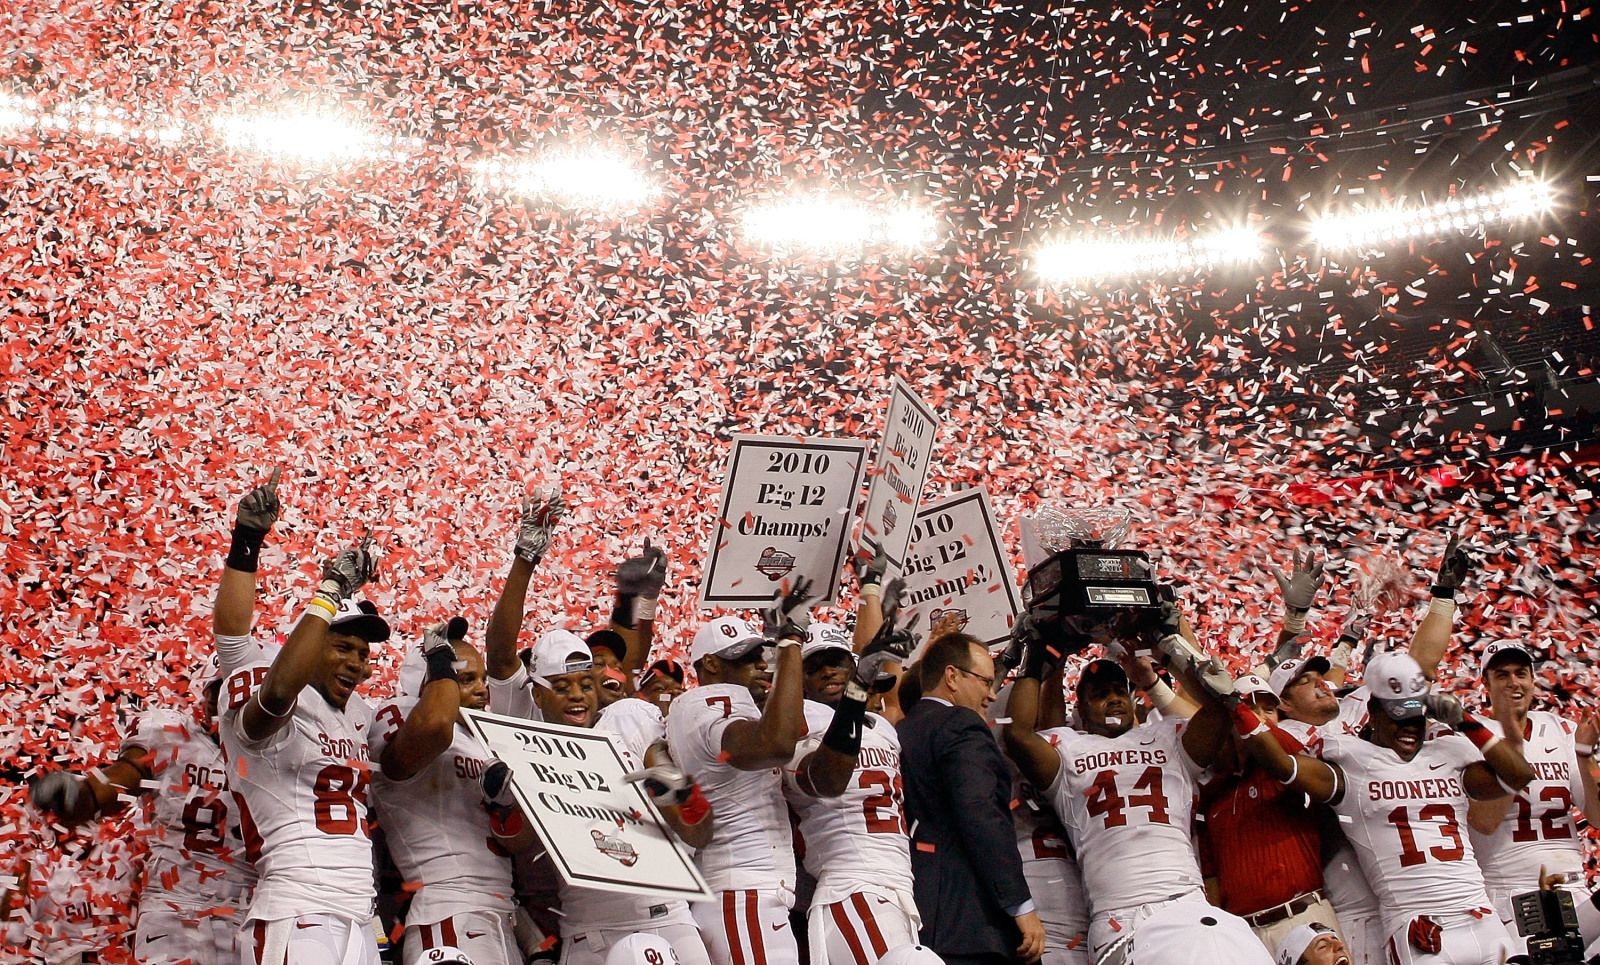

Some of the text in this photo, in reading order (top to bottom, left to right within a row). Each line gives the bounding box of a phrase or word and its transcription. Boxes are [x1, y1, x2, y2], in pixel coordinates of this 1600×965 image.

[902, 404, 924, 439] 2010
[766, 451, 830, 475] 2010
[907, 445, 919, 471] 12
[756, 483, 826, 511] Big 12
[738, 515, 831, 543] Champs!
[910, 513, 954, 543] 010
[902, 540, 966, 576] Big 12
[721, 624, 738, 639] OU
[705, 695, 732, 719] 7
[514, 731, 587, 761] 2010
[1075, 749, 1167, 775] SOONERS
[1528, 762, 1570, 781] NERS
[528, 762, 611, 793] Big 12
[1368, 778, 1461, 801] SOONERS
[1086, 765, 1171, 830] 44
[1512, 786, 1572, 842] 12
[1387, 803, 1465, 868] 13
[428, 948, 445, 961] OU
[644, 947, 664, 965] OU
